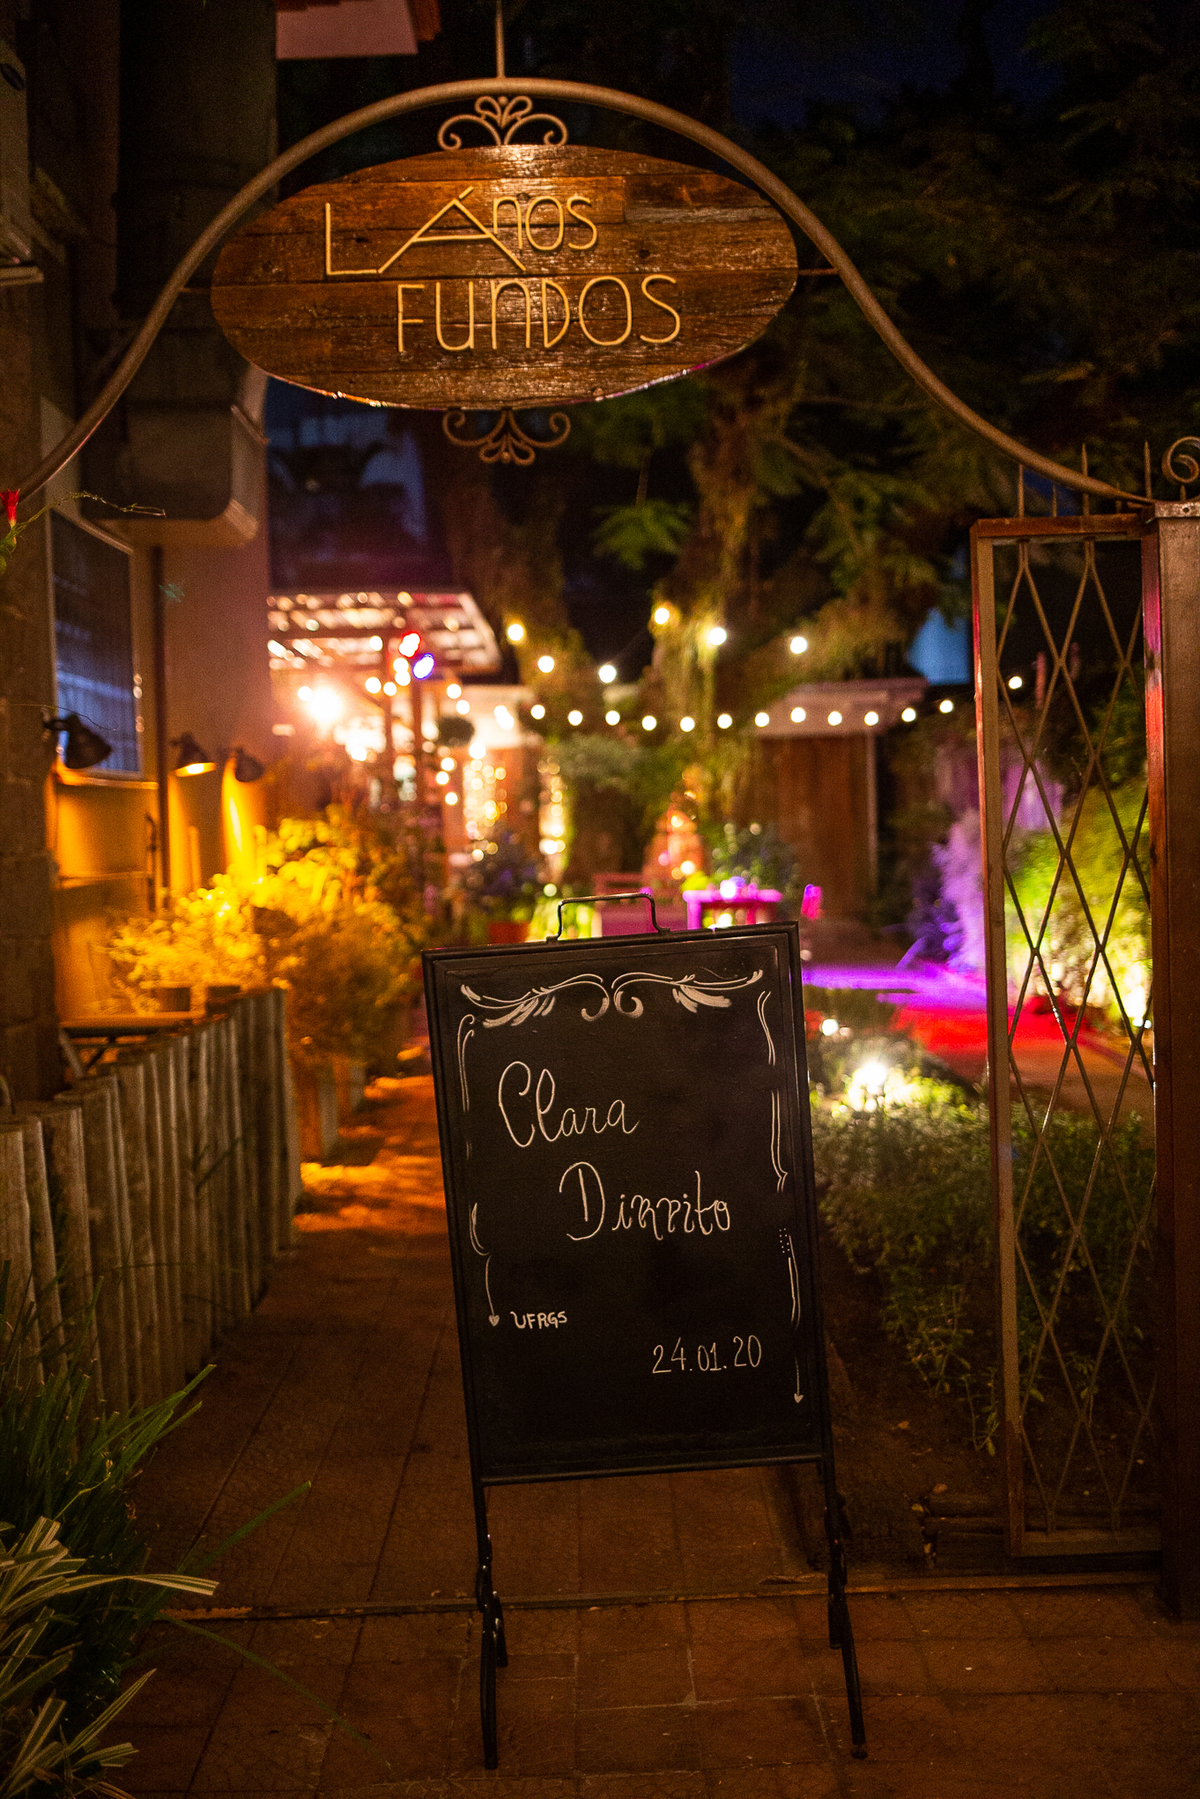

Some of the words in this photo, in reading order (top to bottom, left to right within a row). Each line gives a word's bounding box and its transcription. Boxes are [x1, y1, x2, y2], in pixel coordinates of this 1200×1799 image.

[498, 1060, 640, 1148] Clara
[510, 1311, 568, 1329] UFRGS
[652, 1335, 762, 1373] 24.01.20
